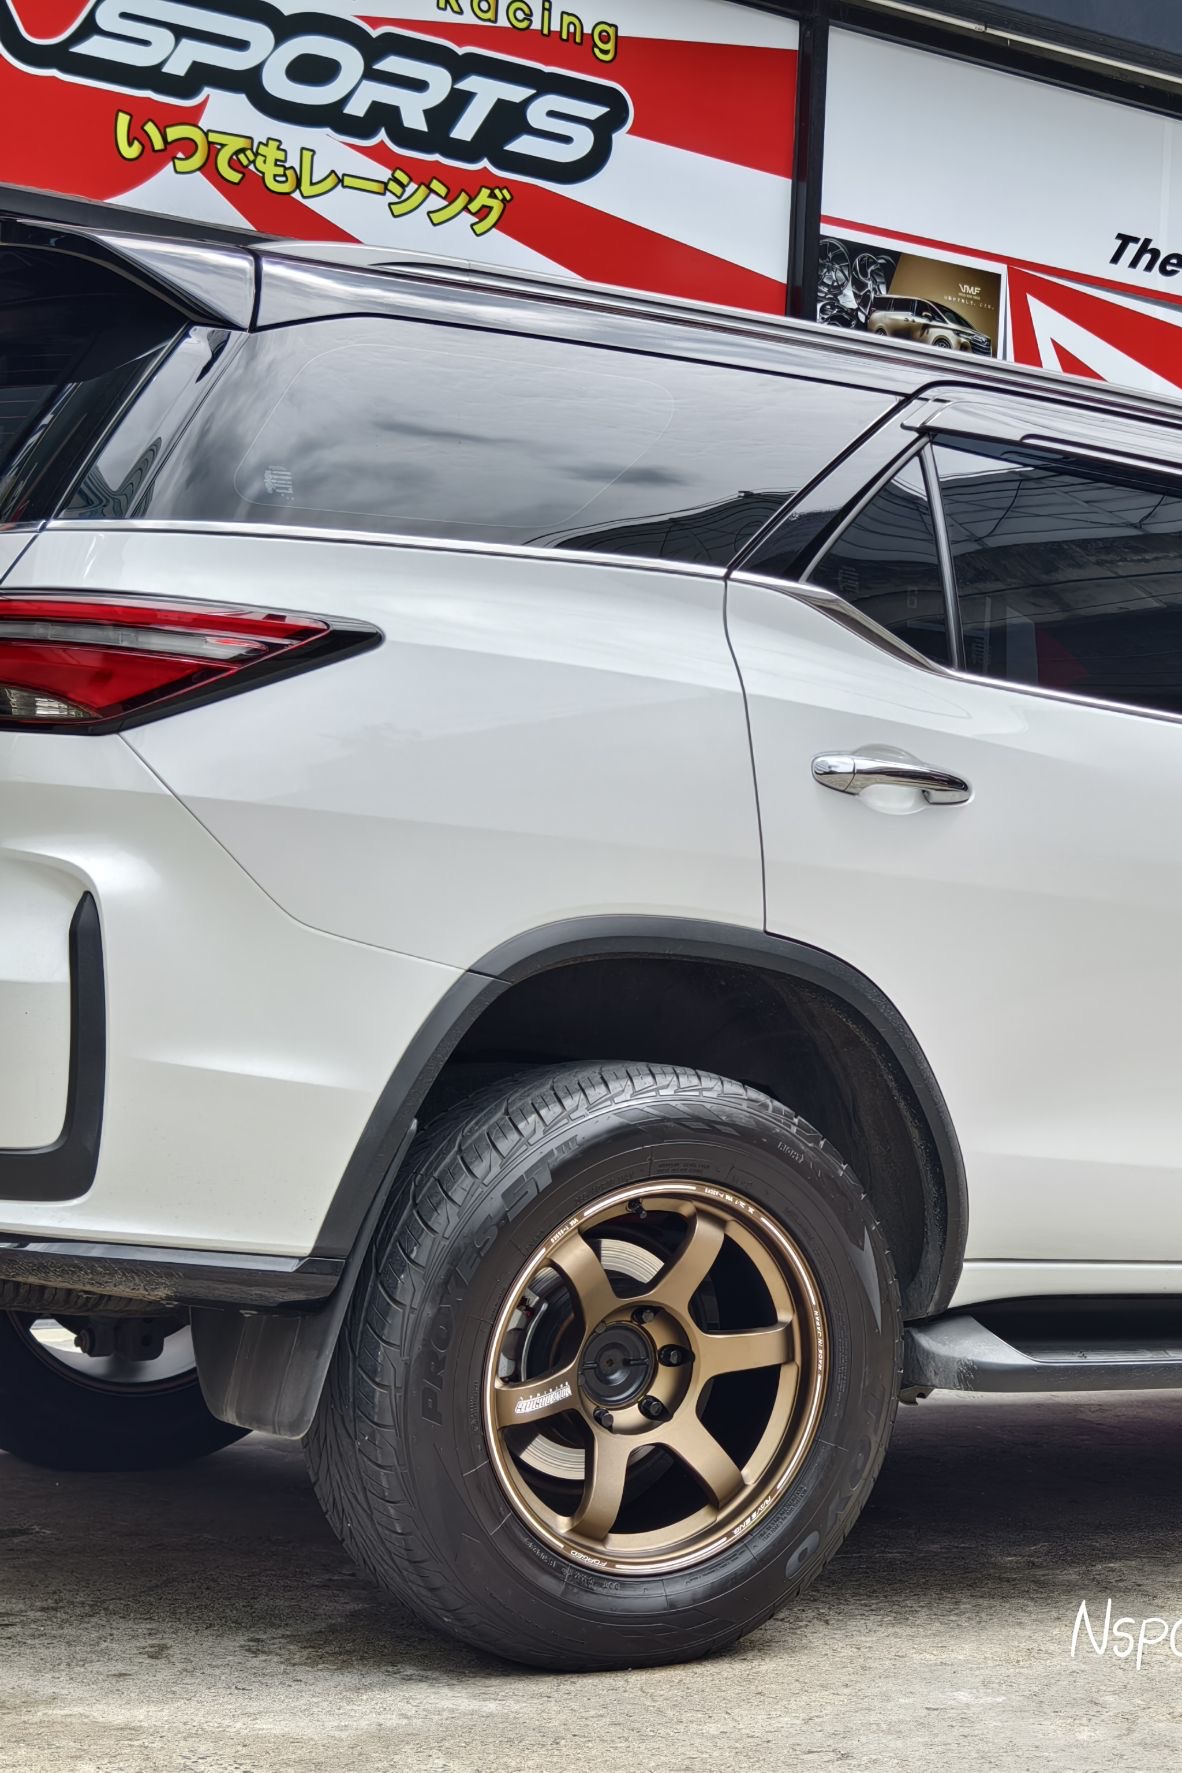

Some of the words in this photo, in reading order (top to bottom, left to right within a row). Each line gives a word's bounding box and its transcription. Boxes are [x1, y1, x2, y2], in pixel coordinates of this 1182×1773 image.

[114, 109, 512, 236] いつでもレーシング
[813, 1310, 823, 1337] JAPAN
